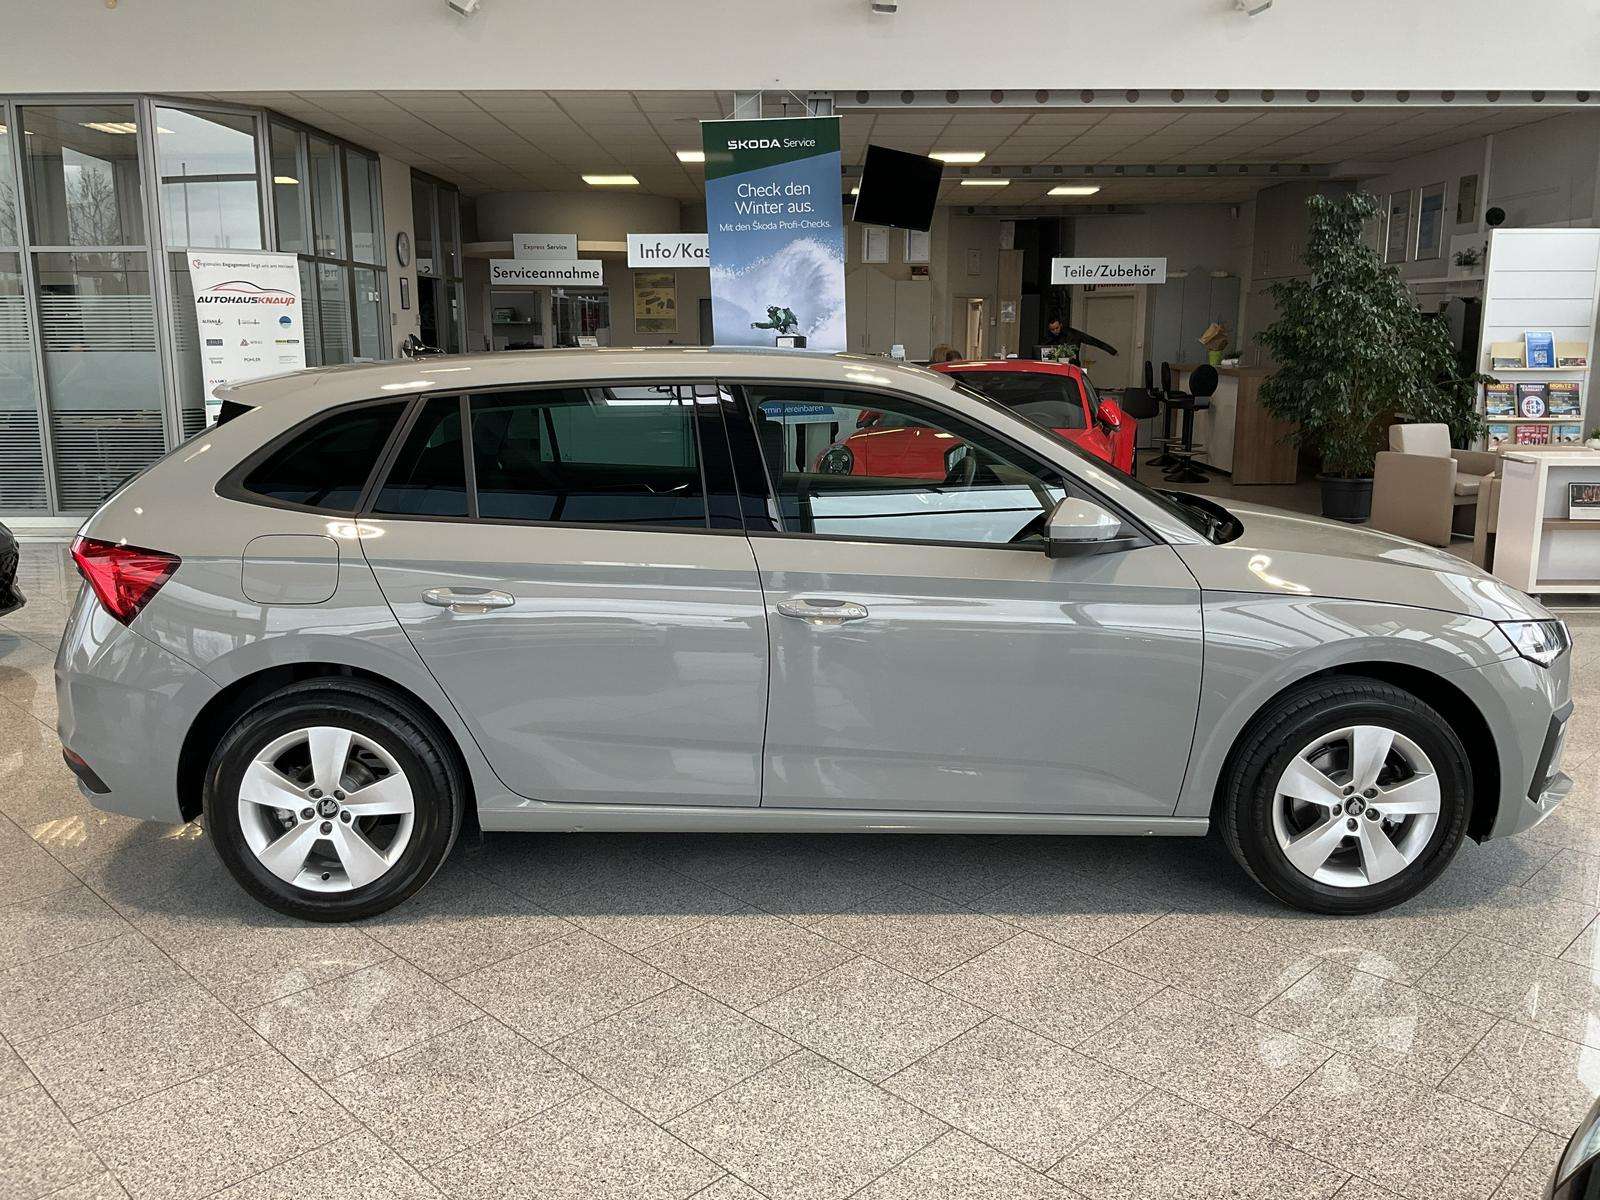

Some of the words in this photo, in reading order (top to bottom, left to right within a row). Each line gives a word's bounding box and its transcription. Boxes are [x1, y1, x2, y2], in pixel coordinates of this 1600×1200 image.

[783, 138, 816, 148] Service
[737, 182, 782, 198] Check
[784, 182, 811, 196] den
[734, 201, 783, 215] Winter
[787, 202, 815, 213] aus.
[719, 223, 734, 232] Mit
[735, 222, 751, 231] den
[779, 220, 832, 230] Profi-Checks.
[639, 243, 710, 259] Info/Kas
[493, 266, 600, 279] Serviceannahme
[1063, 264, 1156, 277] Teile/Zubehör
